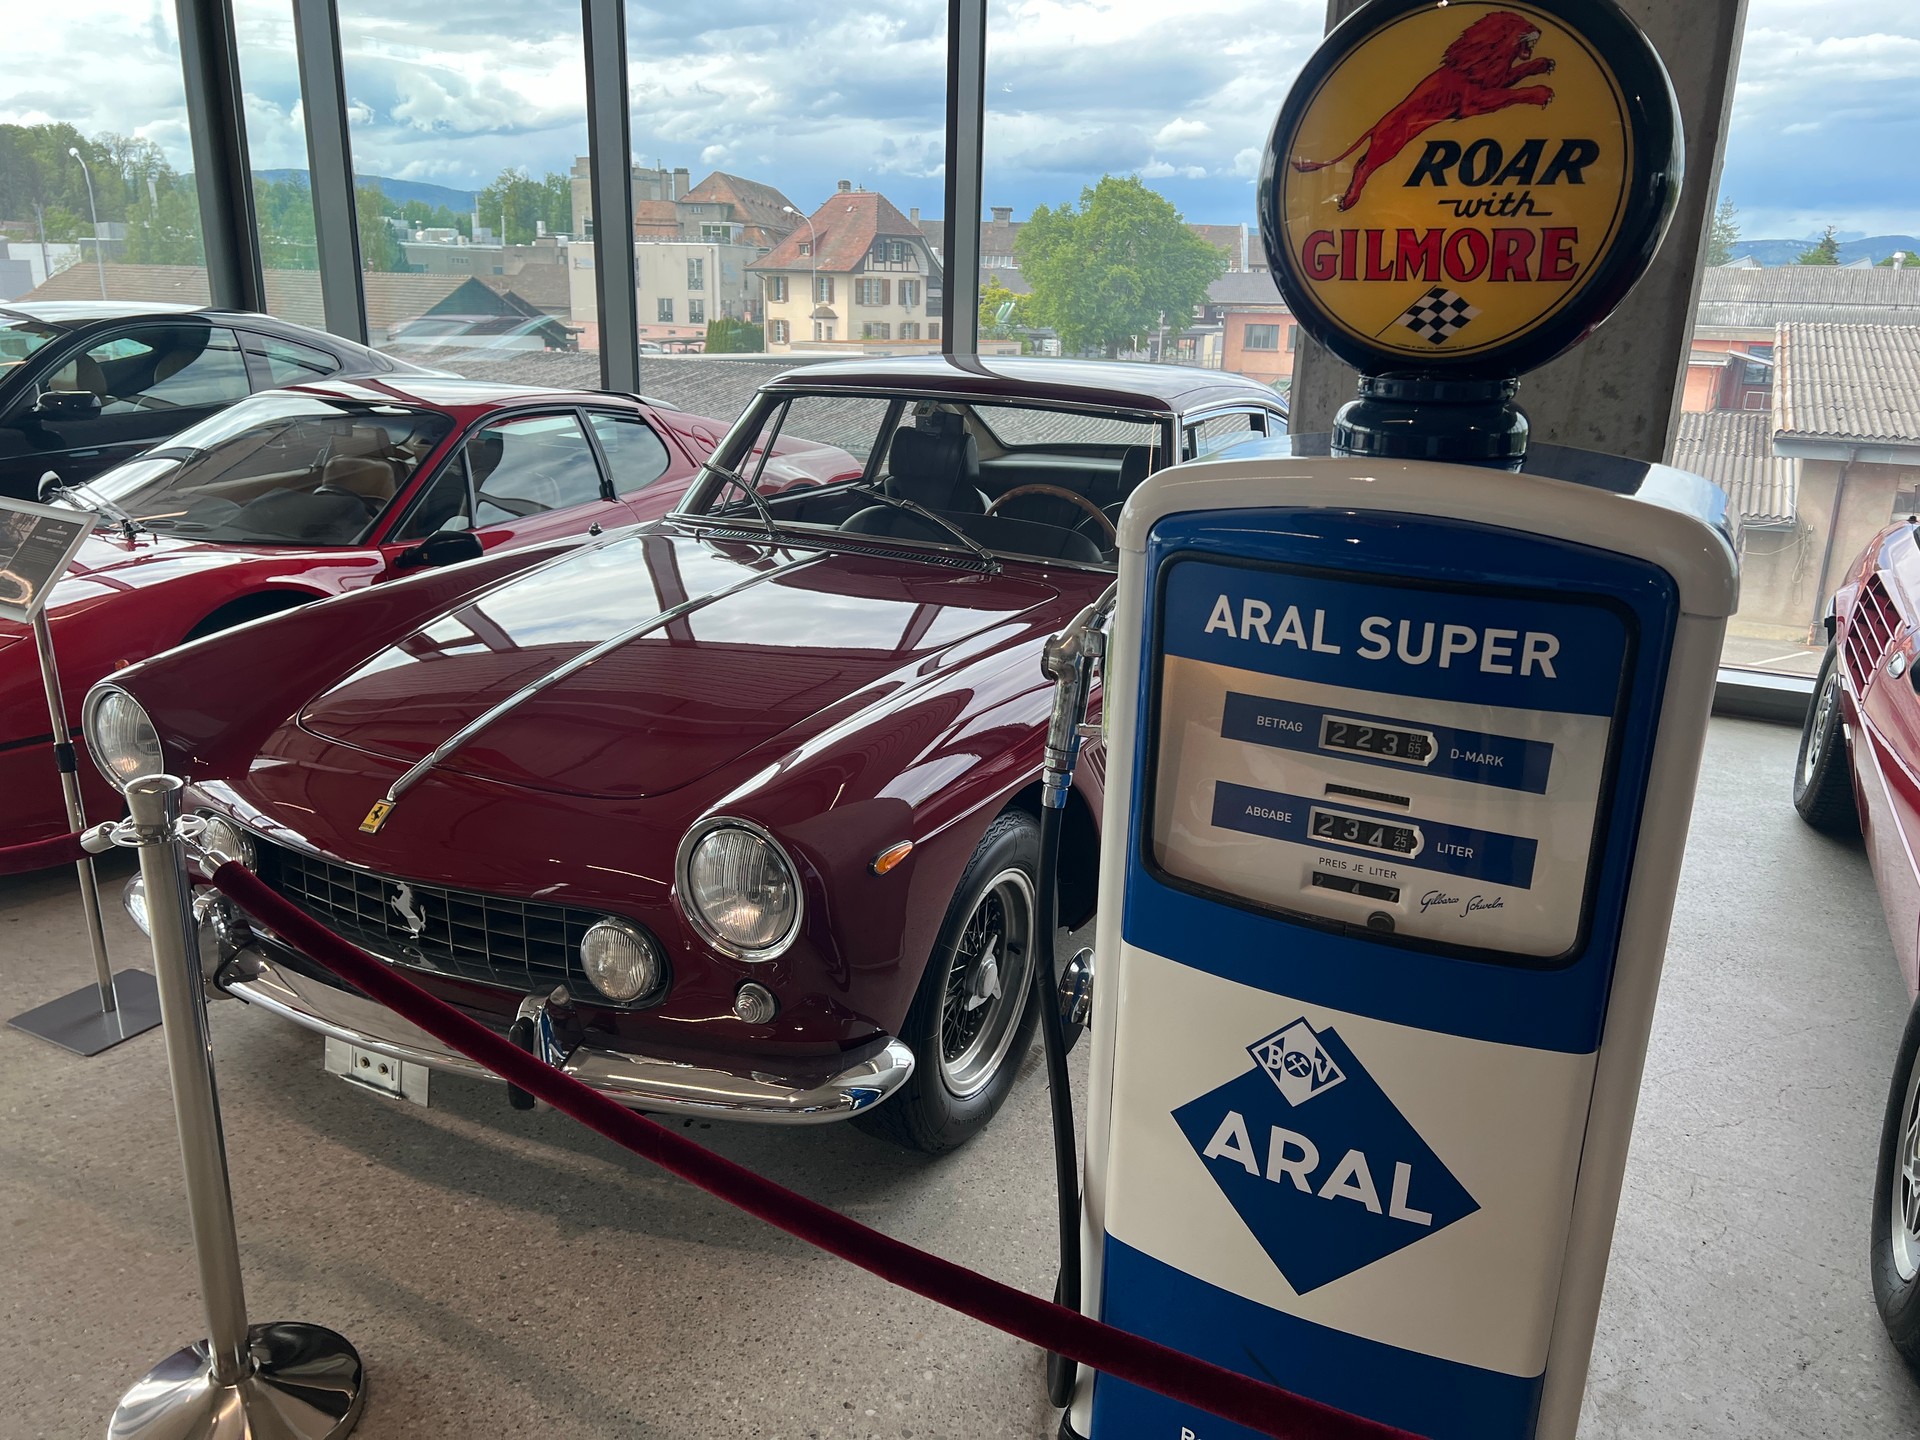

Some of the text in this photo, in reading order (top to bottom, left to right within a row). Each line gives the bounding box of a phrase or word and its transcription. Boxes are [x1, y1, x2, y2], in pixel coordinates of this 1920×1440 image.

[1403, 138, 1600, 187] ROAR
[1437, 190, 1553, 218] with
[1302, 227, 1580, 282] GILMORE
[1204, 594, 1560, 678] ARAL SUPER
[1256, 715, 1303, 733] BETRAG
[1450, 748, 1504, 767] D-MARK
[1245, 805, 1292, 823] ABGABE
[1437, 842, 1474, 859] LITER
[1319, 857, 1397, 879] PREIS JE LITER
[1202, 1110, 1433, 1226] ARAL
